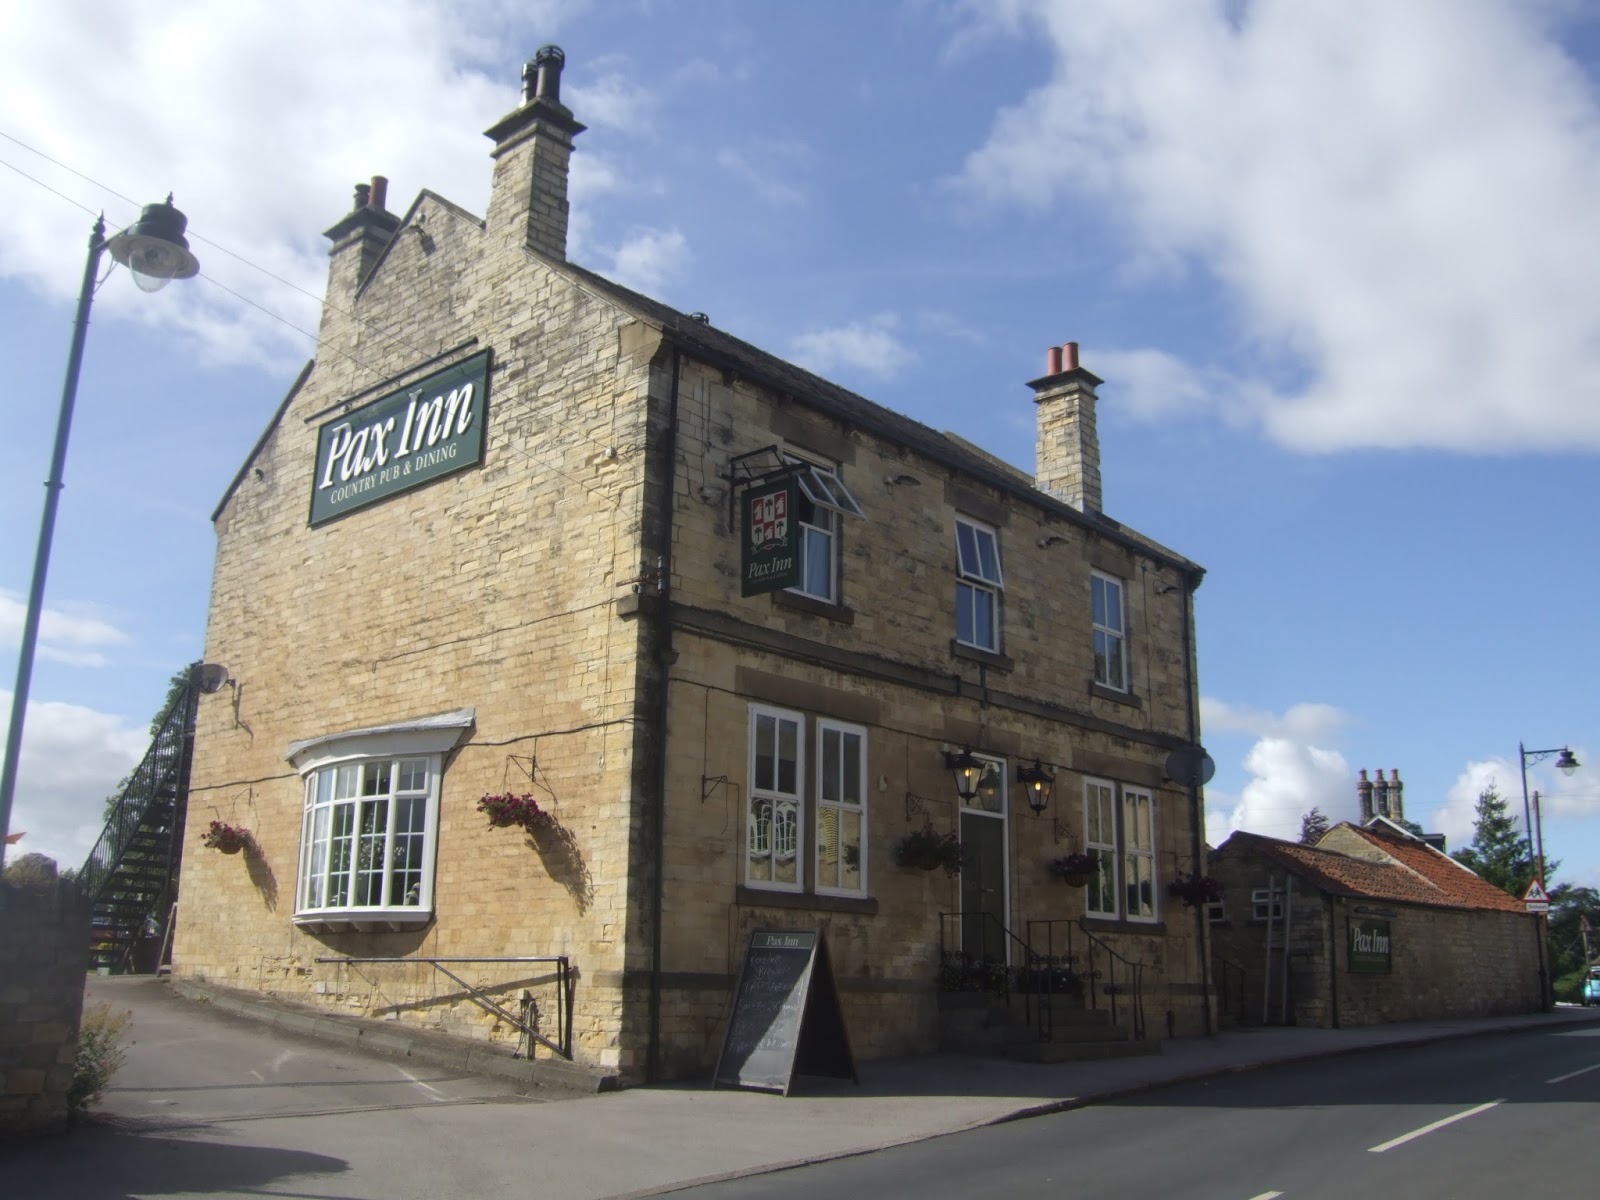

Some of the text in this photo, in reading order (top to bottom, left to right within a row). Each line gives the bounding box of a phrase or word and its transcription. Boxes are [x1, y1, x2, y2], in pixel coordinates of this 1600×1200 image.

[319, 383, 474, 490] Pax Inn
[330, 443, 457, 504] COUNTRY PUB & DINING
[747, 557, 792, 578] Pax Inn
[766, 935, 799, 946] Pax Inn
[1353, 927, 1388, 953] Pax Inn
